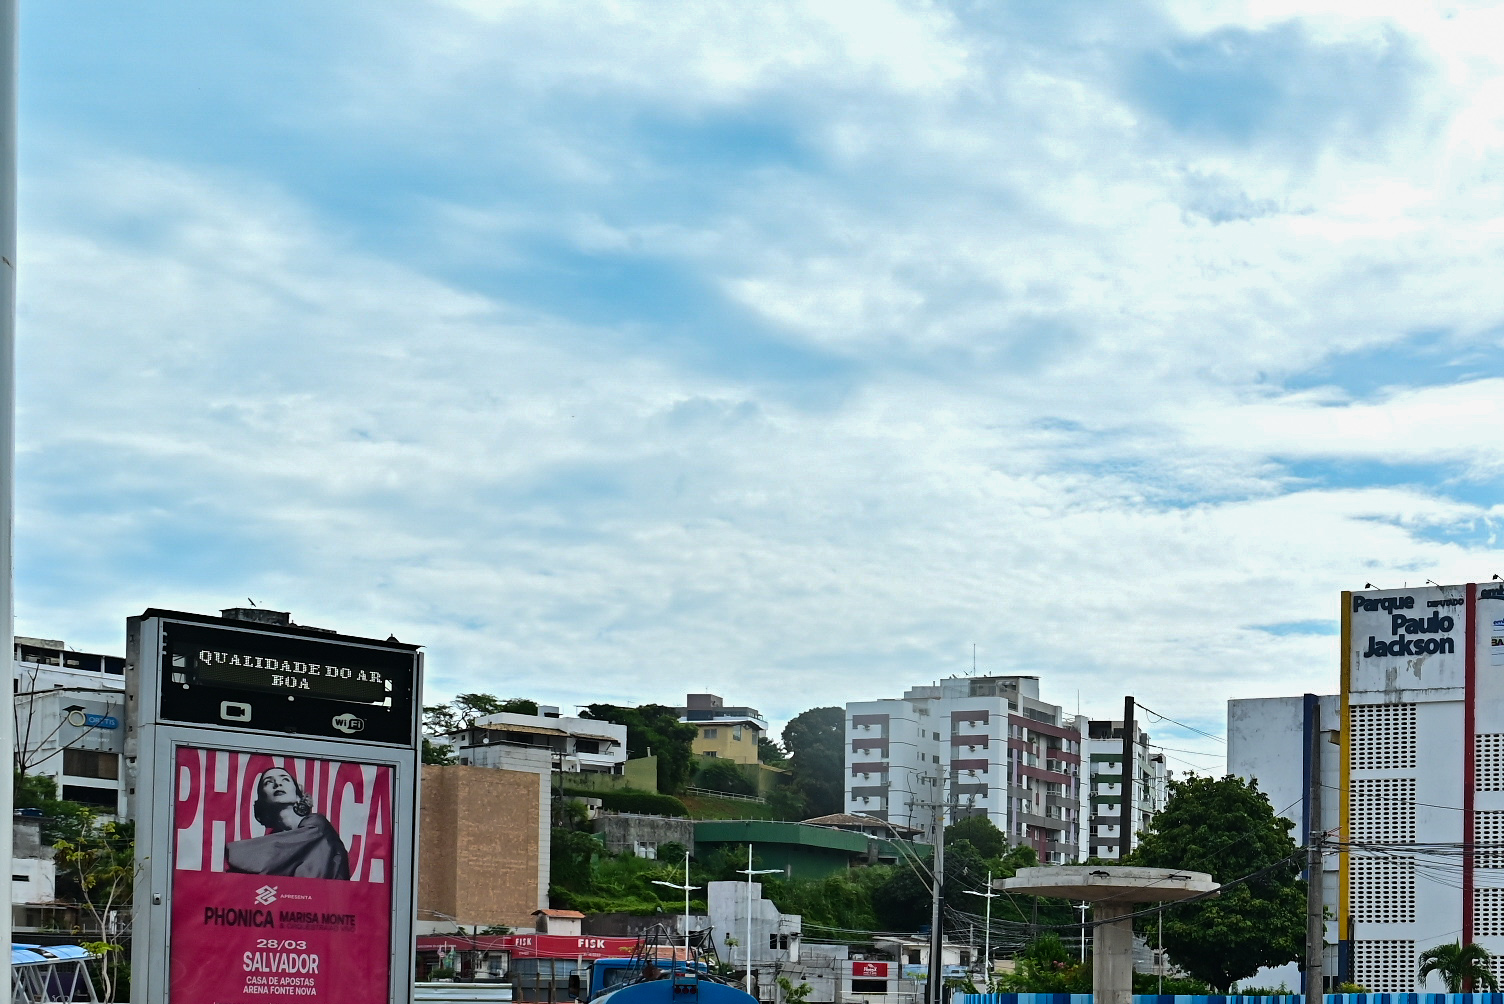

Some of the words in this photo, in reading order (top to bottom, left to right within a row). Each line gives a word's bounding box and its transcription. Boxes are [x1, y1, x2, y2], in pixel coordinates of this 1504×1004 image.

[1353, 595, 1415, 615] Parque
[1391, 610, 1455, 636] Paulo
[1363, 633, 1455, 658] Jackson
[199, 650, 321, 675] QUALIDADE
[324, 665, 352, 679] DO
[356, 669, 383, 684] AR
[271, 674, 311, 690] BOA
[204, 906, 275, 929] PHONICA
[279, 911, 319, 924] MARISA
[321, 913, 356, 926] MONTE
[256, 939, 307, 950] 28/03
[515, 937, 532, 947] FISK
[578, 938, 605, 949] FISK
[243, 951, 319, 974] SALVADOR
[246, 976, 267, 985] CASA
[268, 977, 279, 985] DE
[280, 977, 315, 986] APOSTAS
[243, 985, 269, 994] ARENA
[270, 986, 294, 995] FONTE
[295, 987, 317, 996] NOVA
